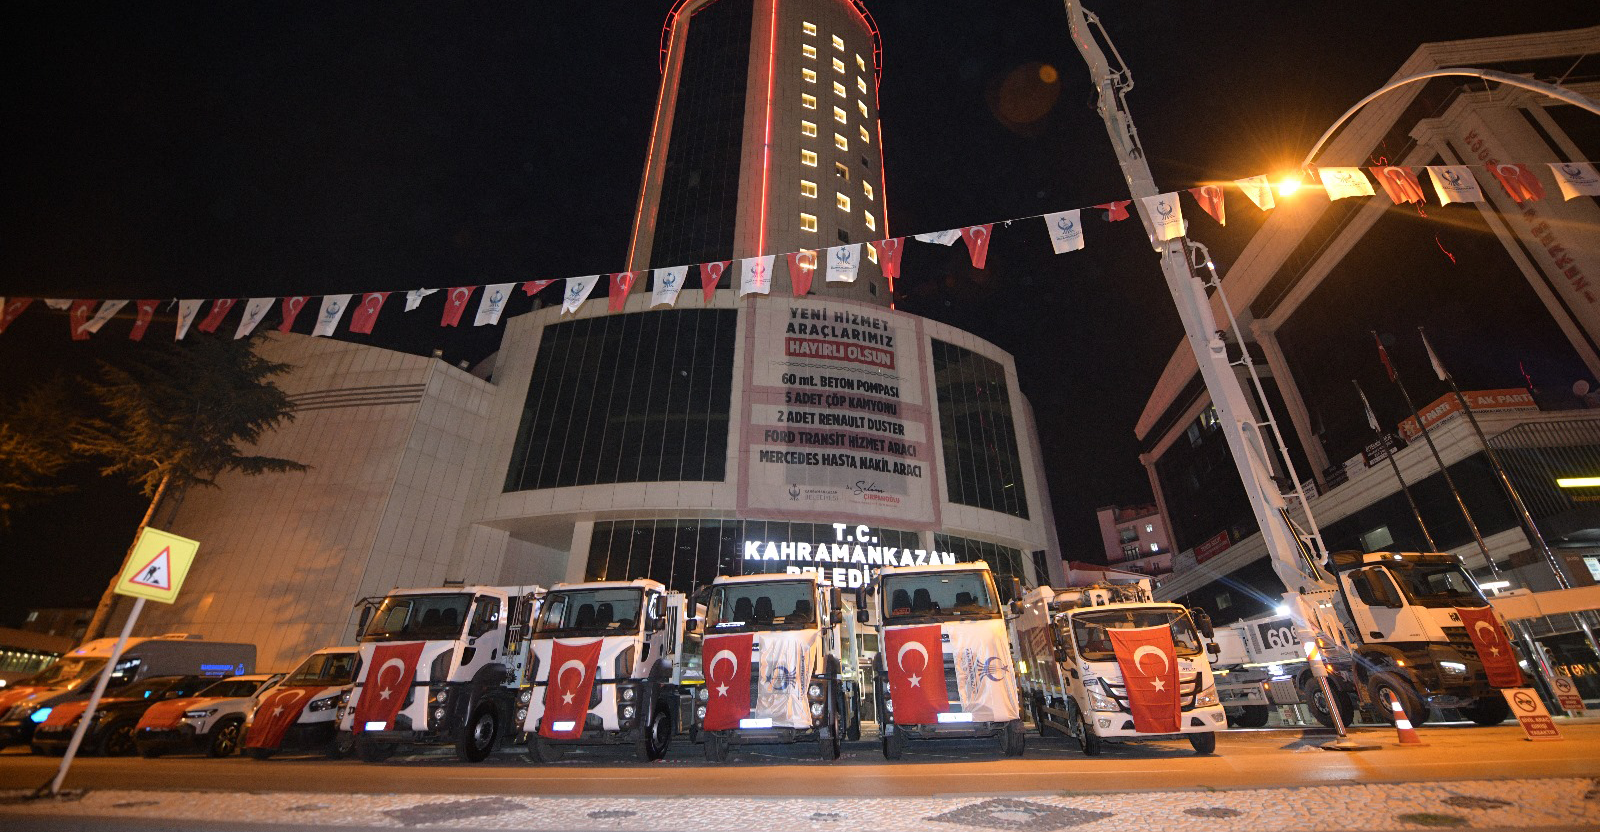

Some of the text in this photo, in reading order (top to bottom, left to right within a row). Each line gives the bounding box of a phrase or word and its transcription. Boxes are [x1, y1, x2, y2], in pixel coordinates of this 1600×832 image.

[790, 306, 889, 332] YENİ HİZMET
[786, 322, 894, 348] ARAÇLARIMIZ
[790, 341, 891, 366] HAYIRLI OLSUN
[782, 373, 900, 398] 60 mt. BETON POMPASI
[785, 392, 897, 416] 5 ADET ÇÖP KAMYONU
[777, 411, 905, 436] 2 ADET RENAULT DUSTER
[765, 430, 917, 457] FORD TRANSİT HİZMET ARACI
[759, 450, 922, 478] MERCEDES HASTA NAKİL ARACI
[832, 522, 878, 543] T.C.
[744, 541, 956, 567] KAHRAMANKAZAN
